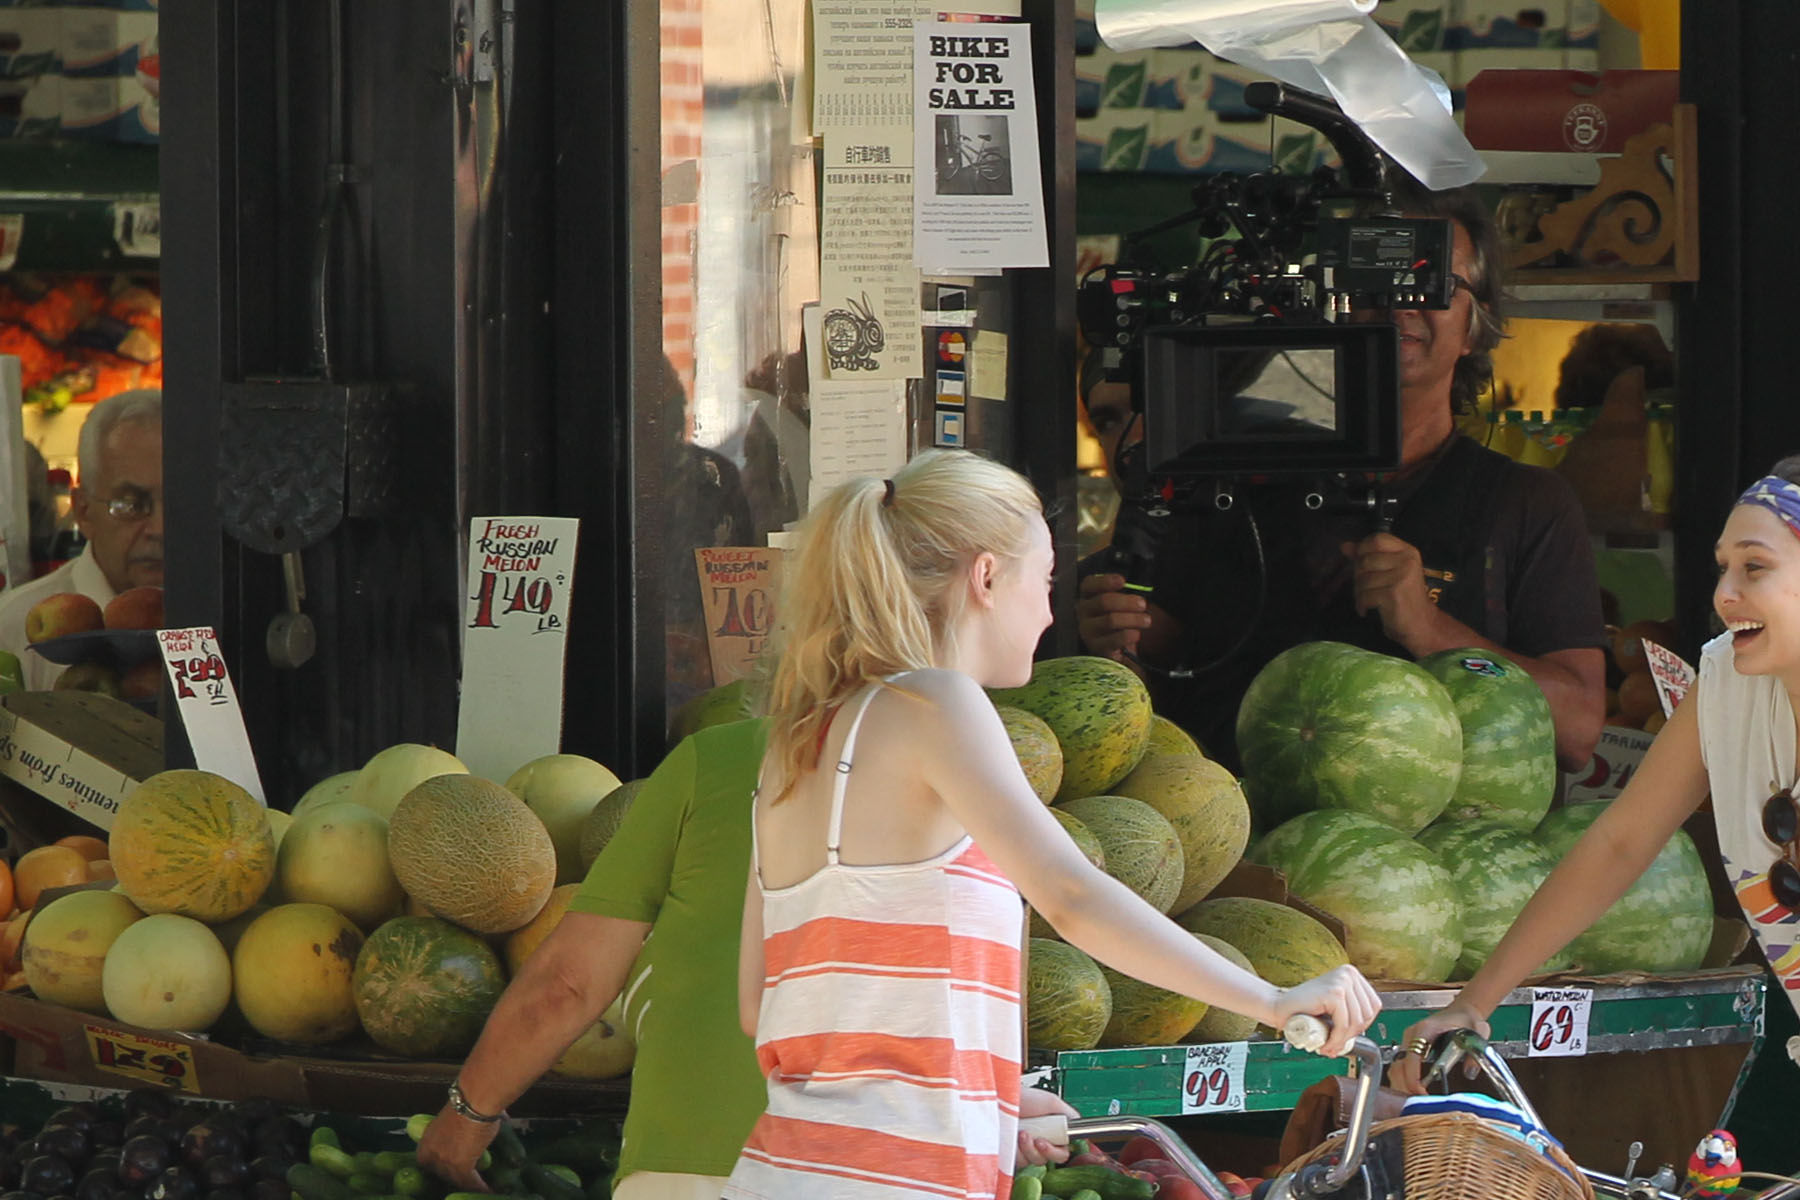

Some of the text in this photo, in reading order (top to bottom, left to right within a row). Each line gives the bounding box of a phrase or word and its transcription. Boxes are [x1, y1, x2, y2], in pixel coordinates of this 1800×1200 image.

[929, 36, 1009, 58] BIKE
[935, 62, 1003, 84] FOR
[928, 88, 1015, 110] SALE
[482, 519, 540, 540] FRESH
[476, 538, 558, 558] RUSSIAN
[483, 554, 541, 572] MELON
[1601, 732, 1653, 752] TARIN
[17, 749, 61, 784] from
[1532, 1005, 1574, 1052] 69
[1186, 1068, 1230, 1108] 99
